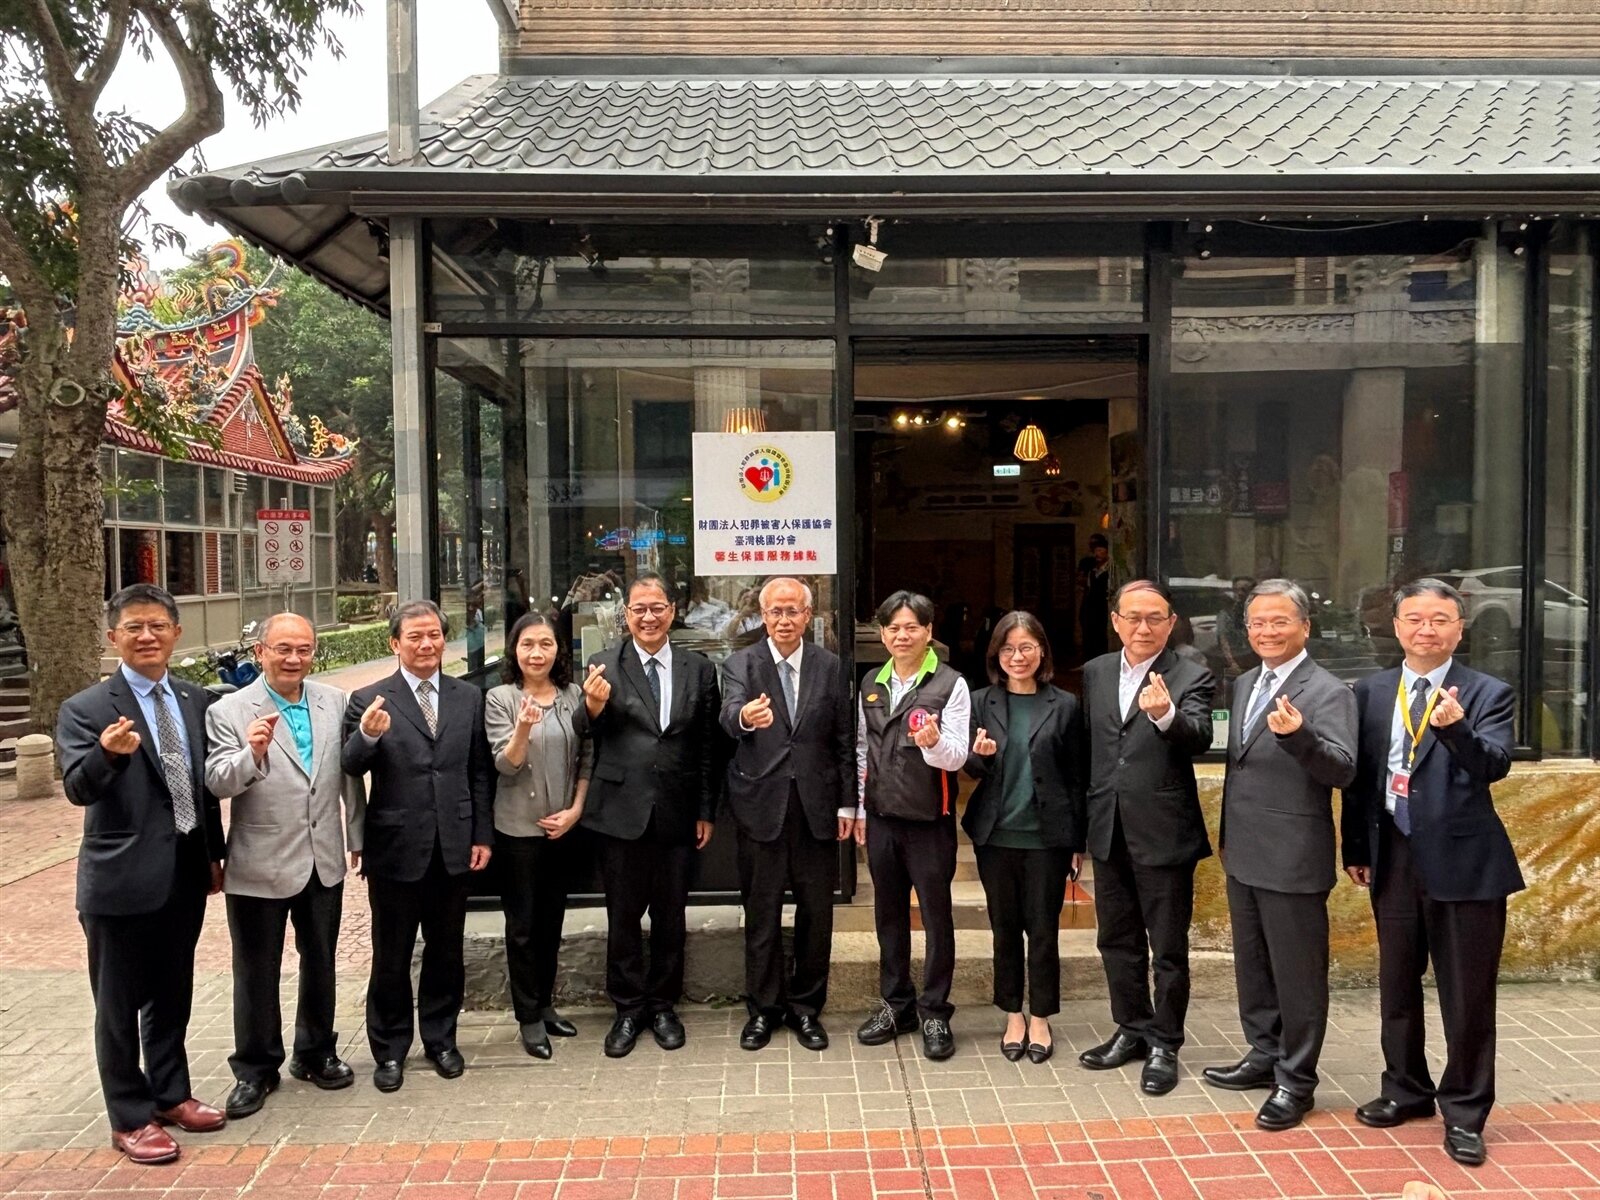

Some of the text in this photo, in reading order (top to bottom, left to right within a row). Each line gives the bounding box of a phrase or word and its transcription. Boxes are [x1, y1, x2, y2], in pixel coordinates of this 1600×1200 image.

[698, 519, 832, 530] 財團法人犯罪被害人保護協會
[735, 534, 796, 546] 臺灣桃園分會
[715, 550, 817, 562] 馨生保護服務據點
